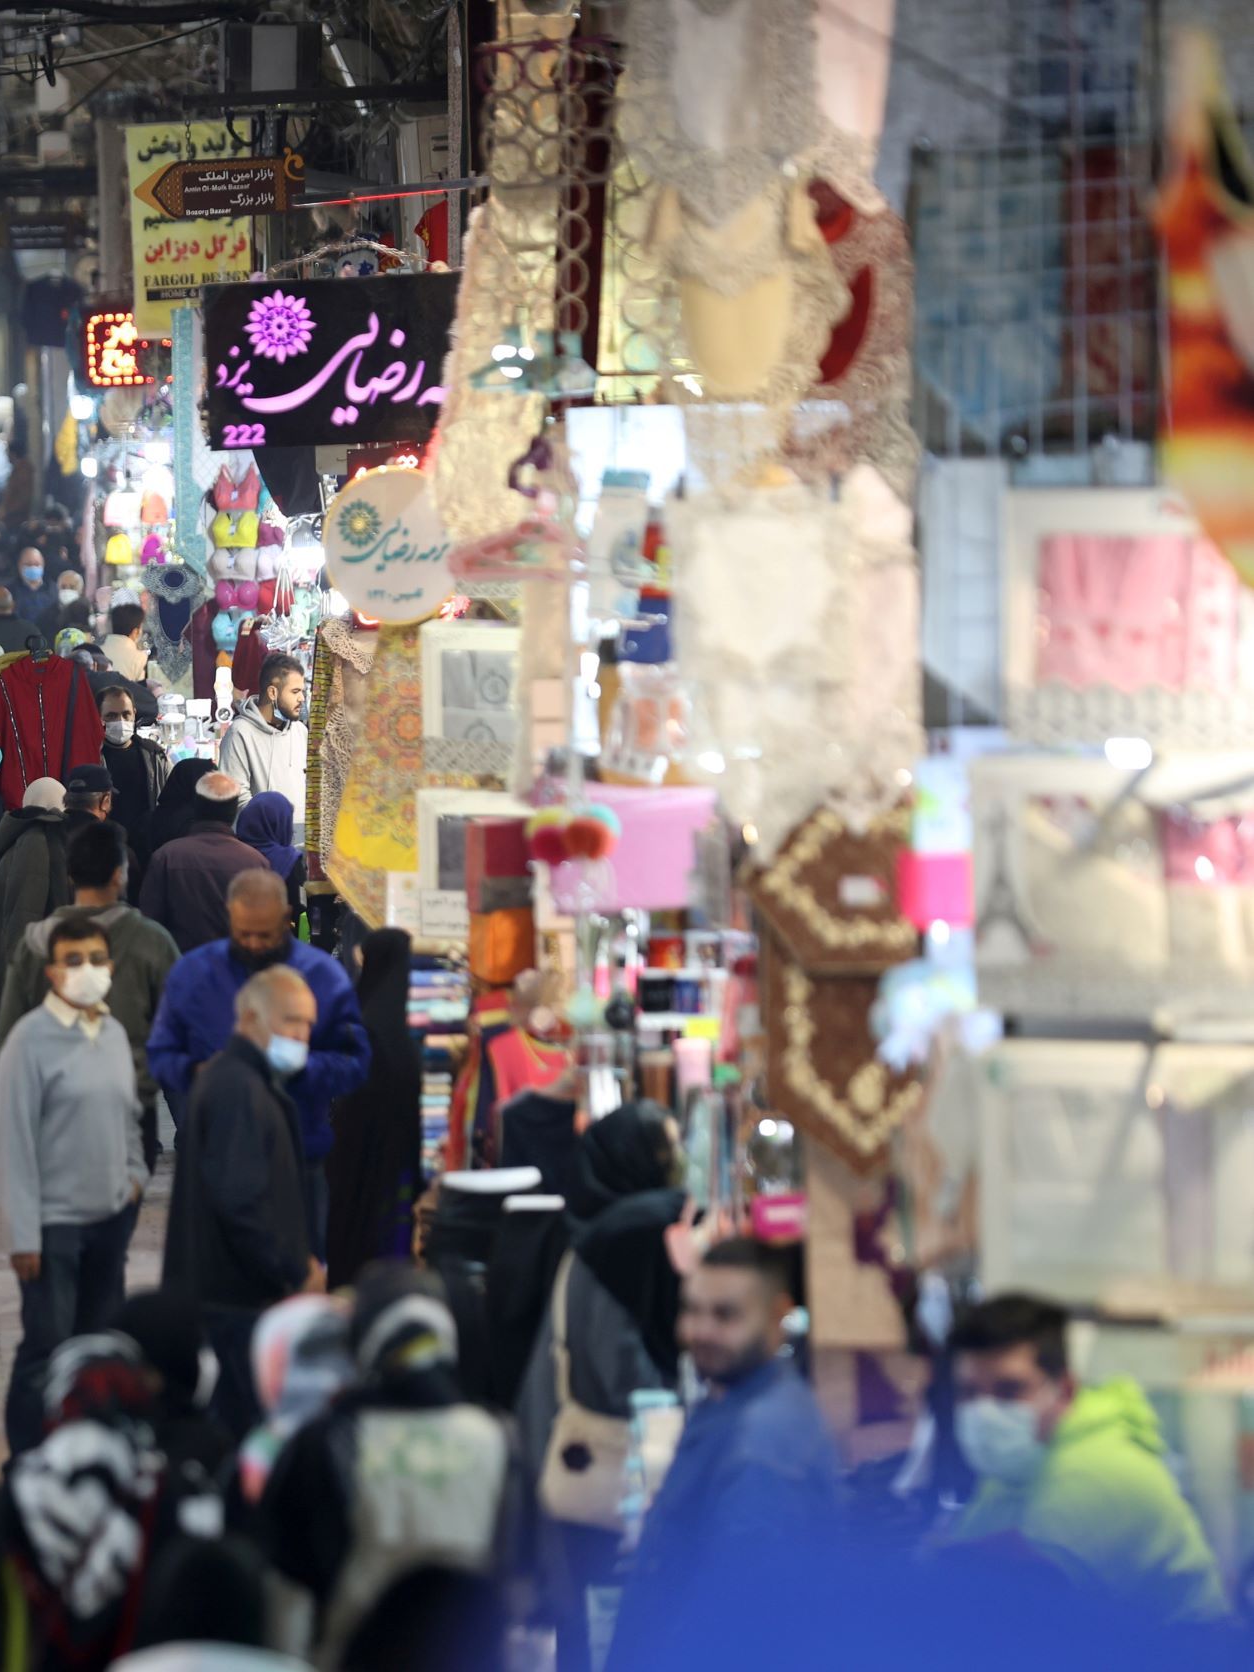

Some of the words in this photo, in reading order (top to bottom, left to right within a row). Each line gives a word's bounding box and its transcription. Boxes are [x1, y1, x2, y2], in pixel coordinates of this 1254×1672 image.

[198, 171, 229, 182] الملک
[231, 170, 254, 182] امین
[254, 169, 274, 181] بازار
[184, 185, 201, 194] Amin
[229, 193, 254, 206] بزرگ
[254, 193, 274, 205] بازار
[143, 272, 199, 287] FARGOL
[160, 289, 187, 298] HOME
[221, 422, 267, 447] 222
